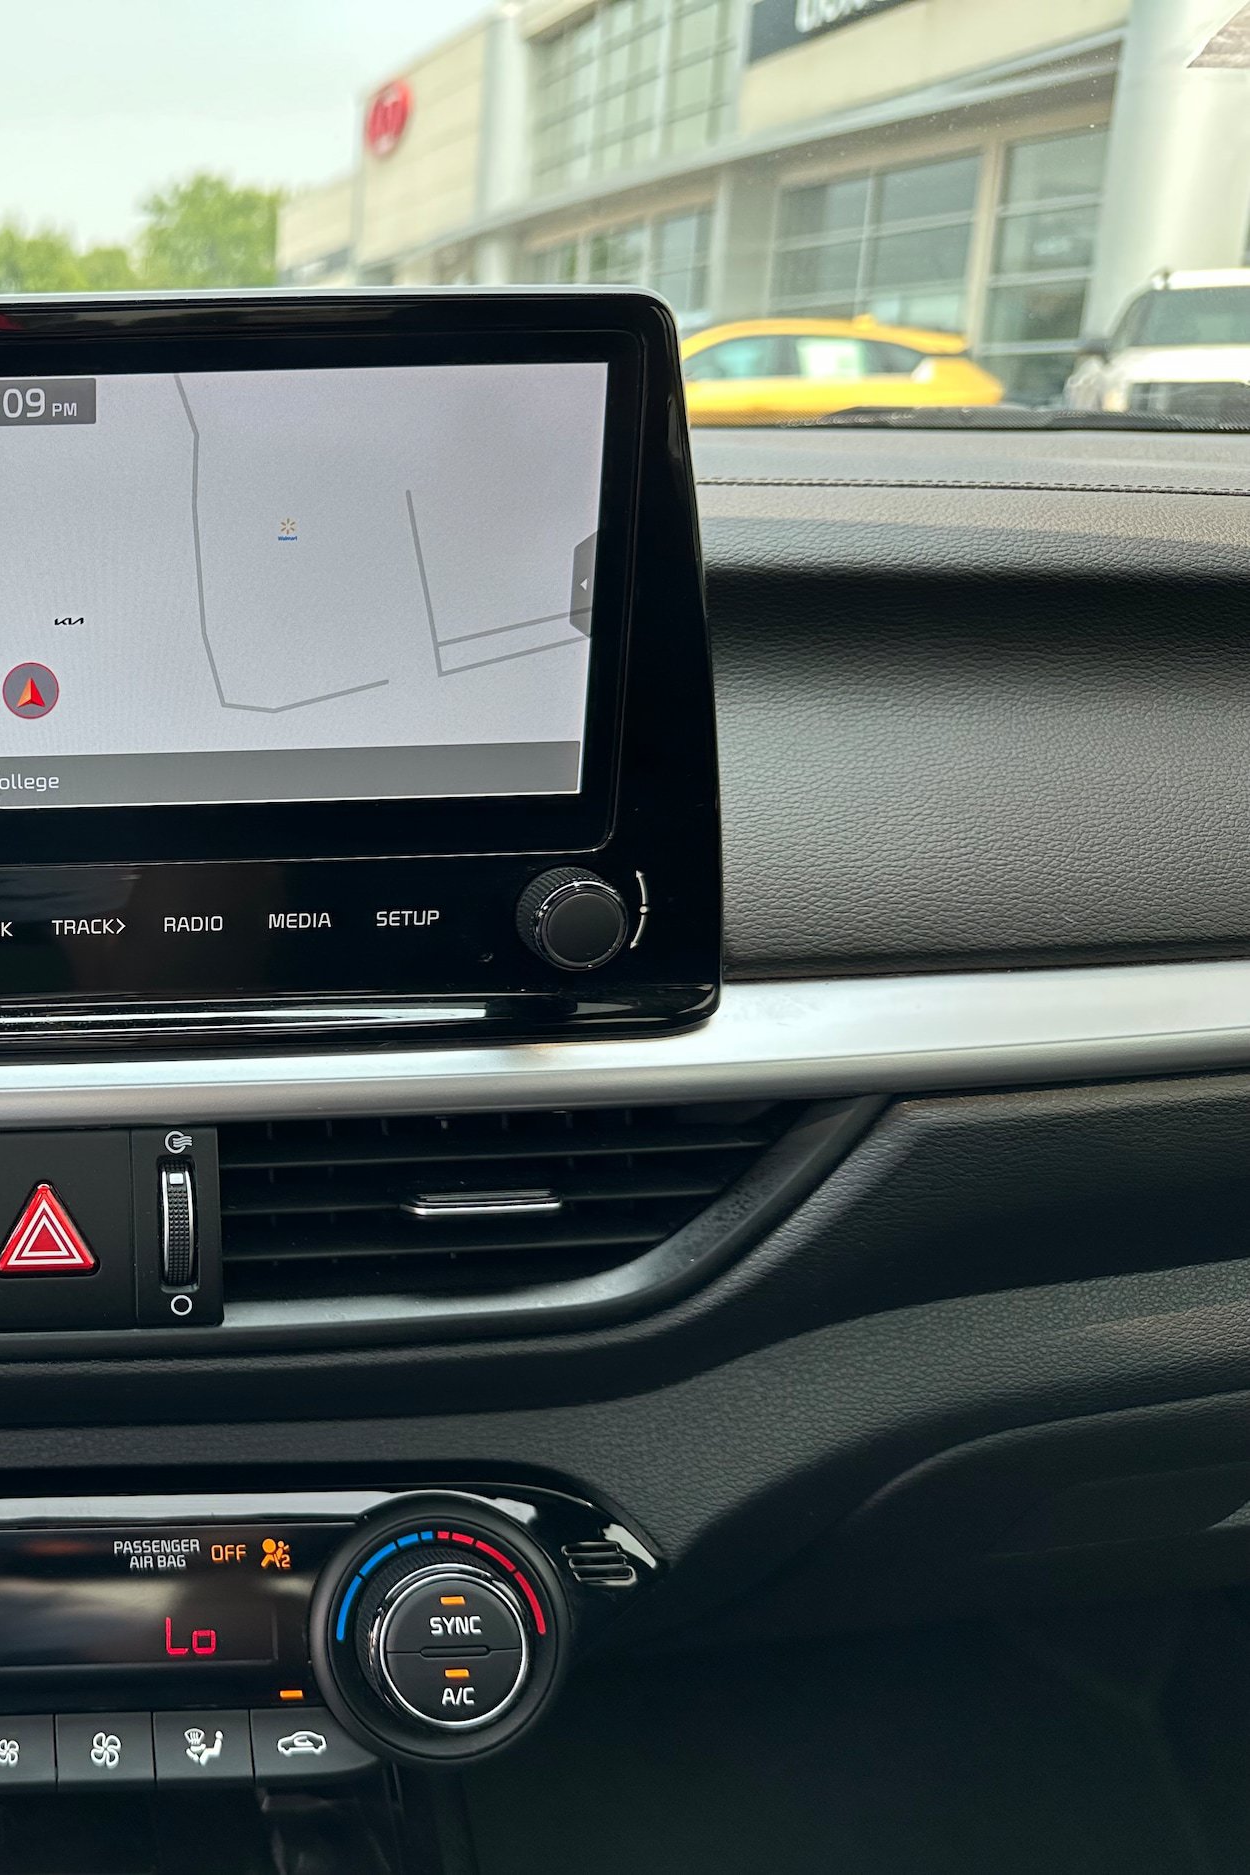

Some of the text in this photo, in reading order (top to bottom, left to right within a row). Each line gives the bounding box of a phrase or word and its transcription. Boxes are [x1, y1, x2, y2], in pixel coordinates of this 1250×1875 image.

[52, 402, 77, 417] PM
[163, 915, 223, 933] RADIO
[268, 912, 332, 929] MEDIA
[376, 910, 440, 927] SETUP
[113, 1539, 200, 1555] PASSENGER
[211, 1544, 246, 1563] OFF
[129, 1554, 187, 1570] AIR BAG
[429, 1615, 483, 1636] SYNC
[441, 1686, 475, 1707] A/C
